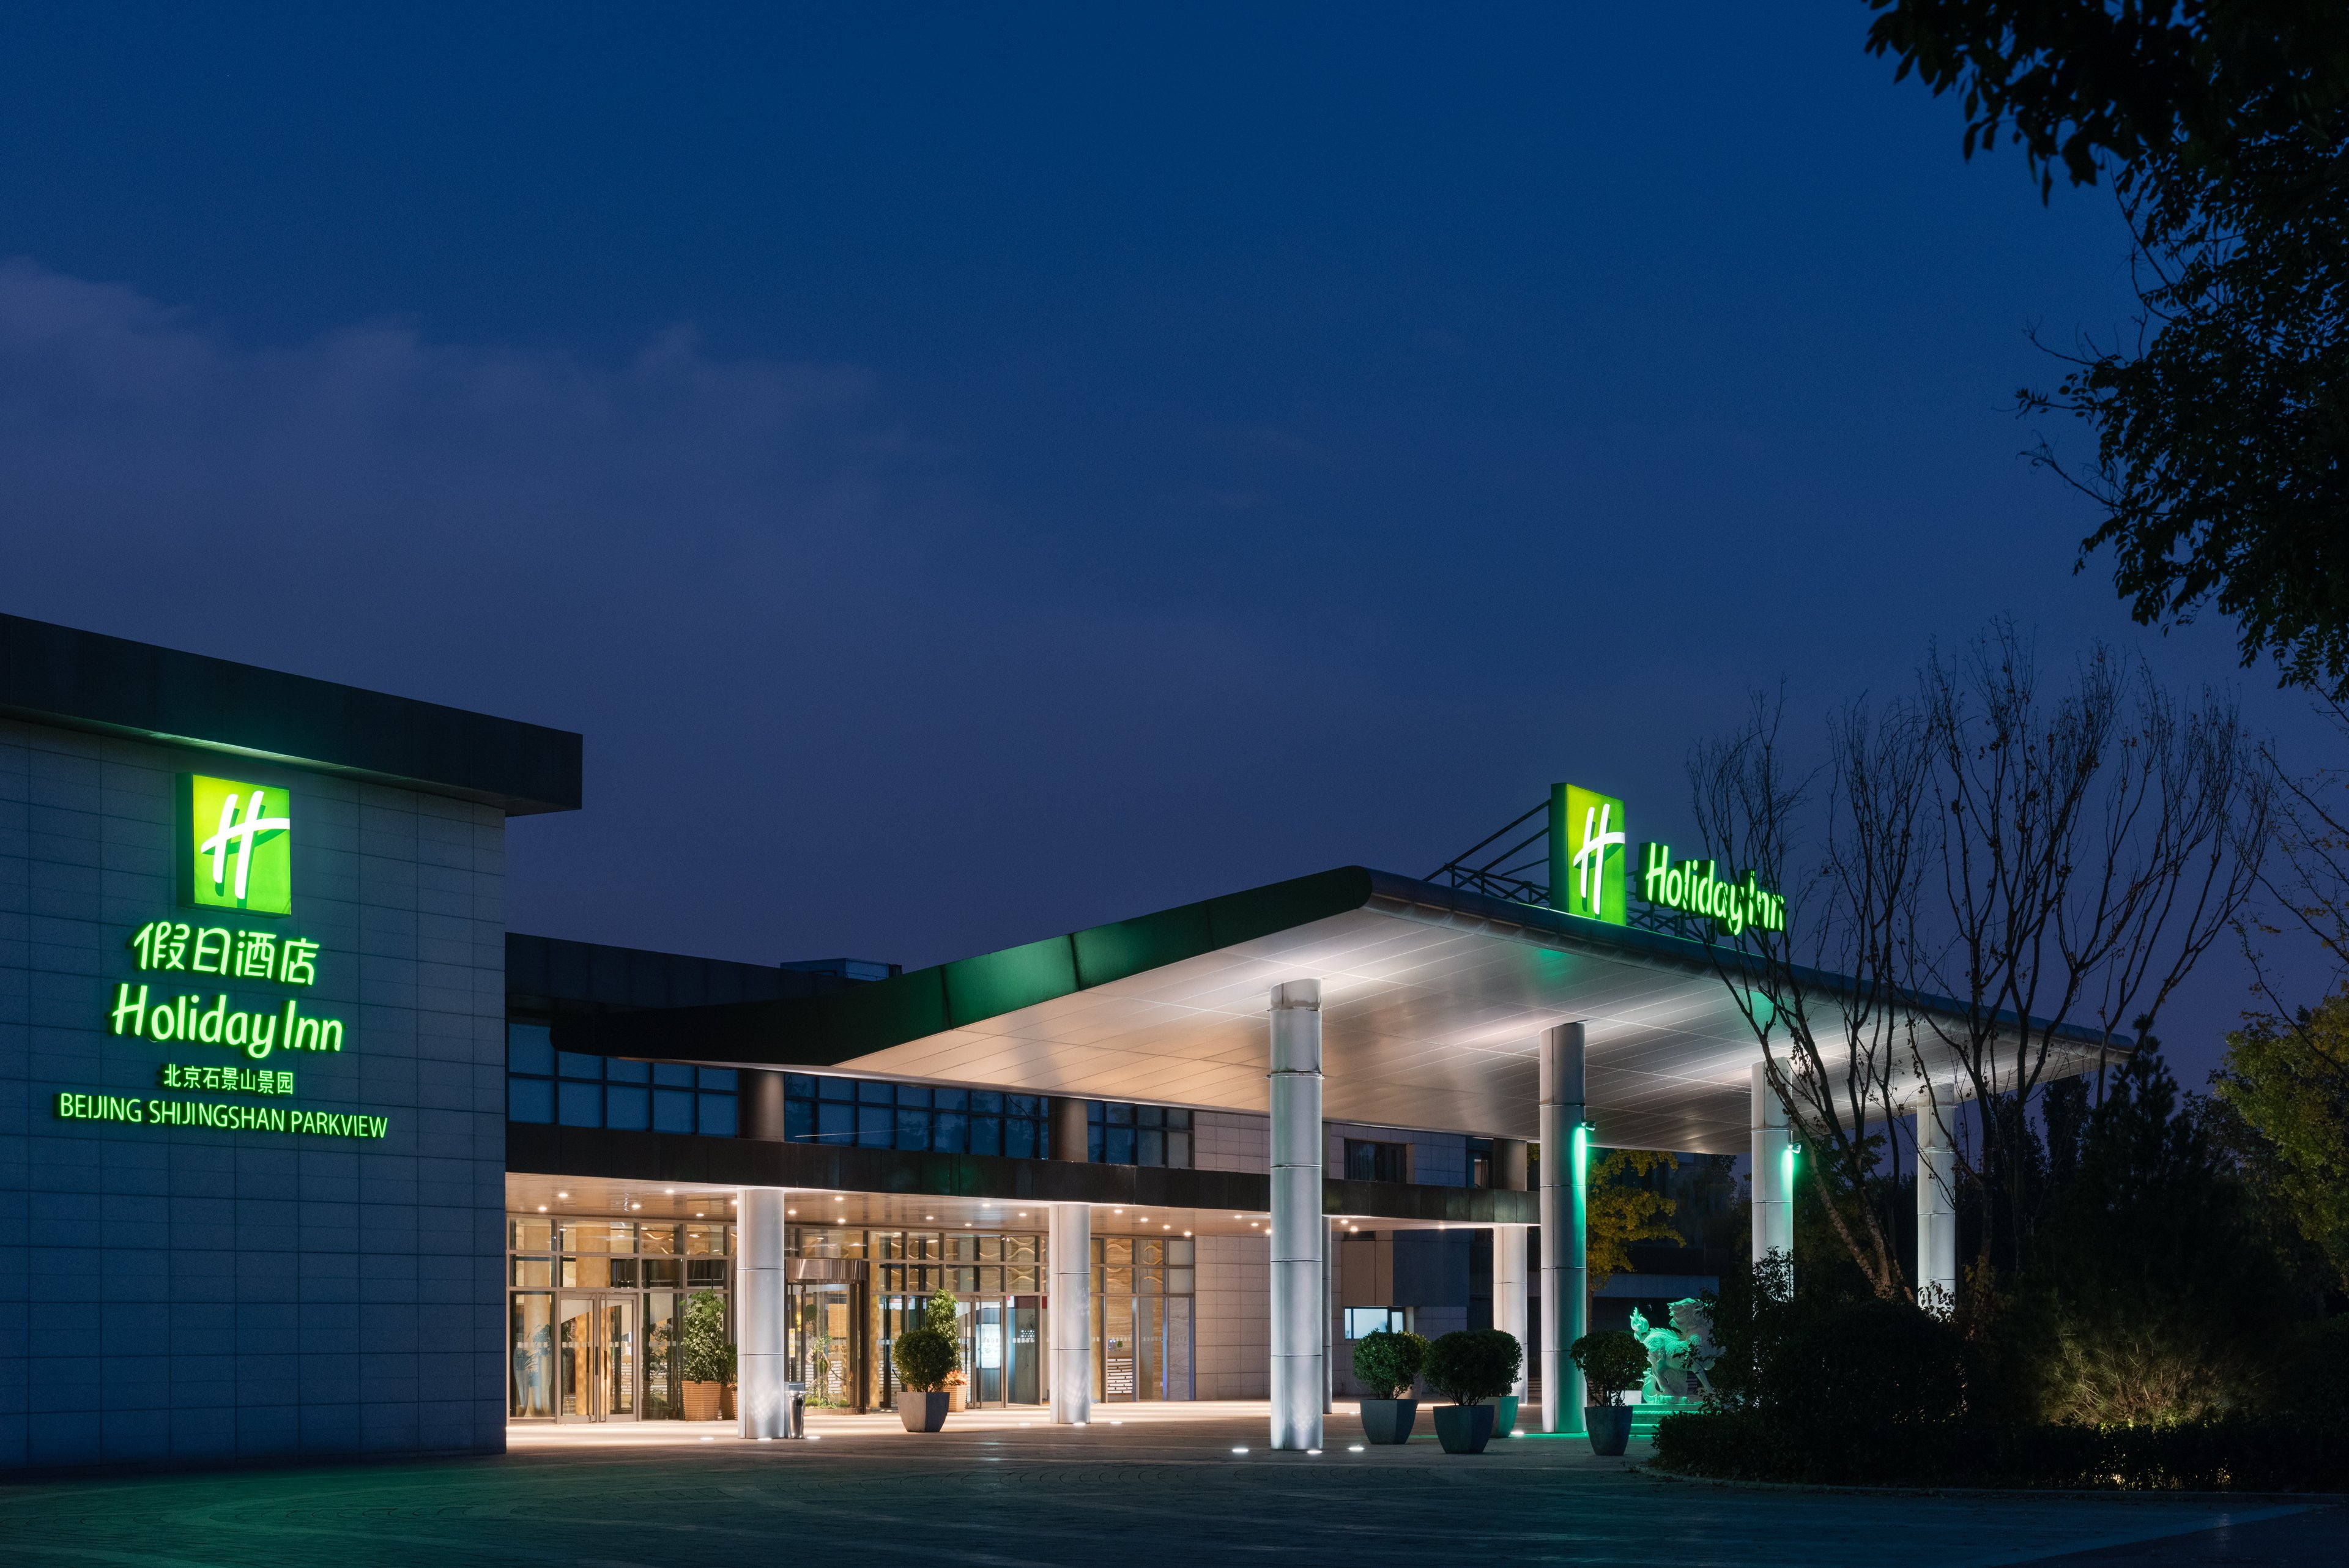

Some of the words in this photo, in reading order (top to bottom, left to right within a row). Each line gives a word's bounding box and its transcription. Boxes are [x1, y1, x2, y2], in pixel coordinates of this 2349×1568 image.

[1646, 842, 1744, 935] Holiday
[133, 921, 320, 986] 假日酒店
[112, 983, 276, 1058] Holiday
[283, 1000, 343, 1052] Inn
[163, 1063, 294, 1094] 北京石景山景园
[61, 1093, 142, 1122] BEIJING
[149, 1099, 285, 1131] SHIJINGSHAN
[291, 1110, 388, 1139] PARKVIEW
